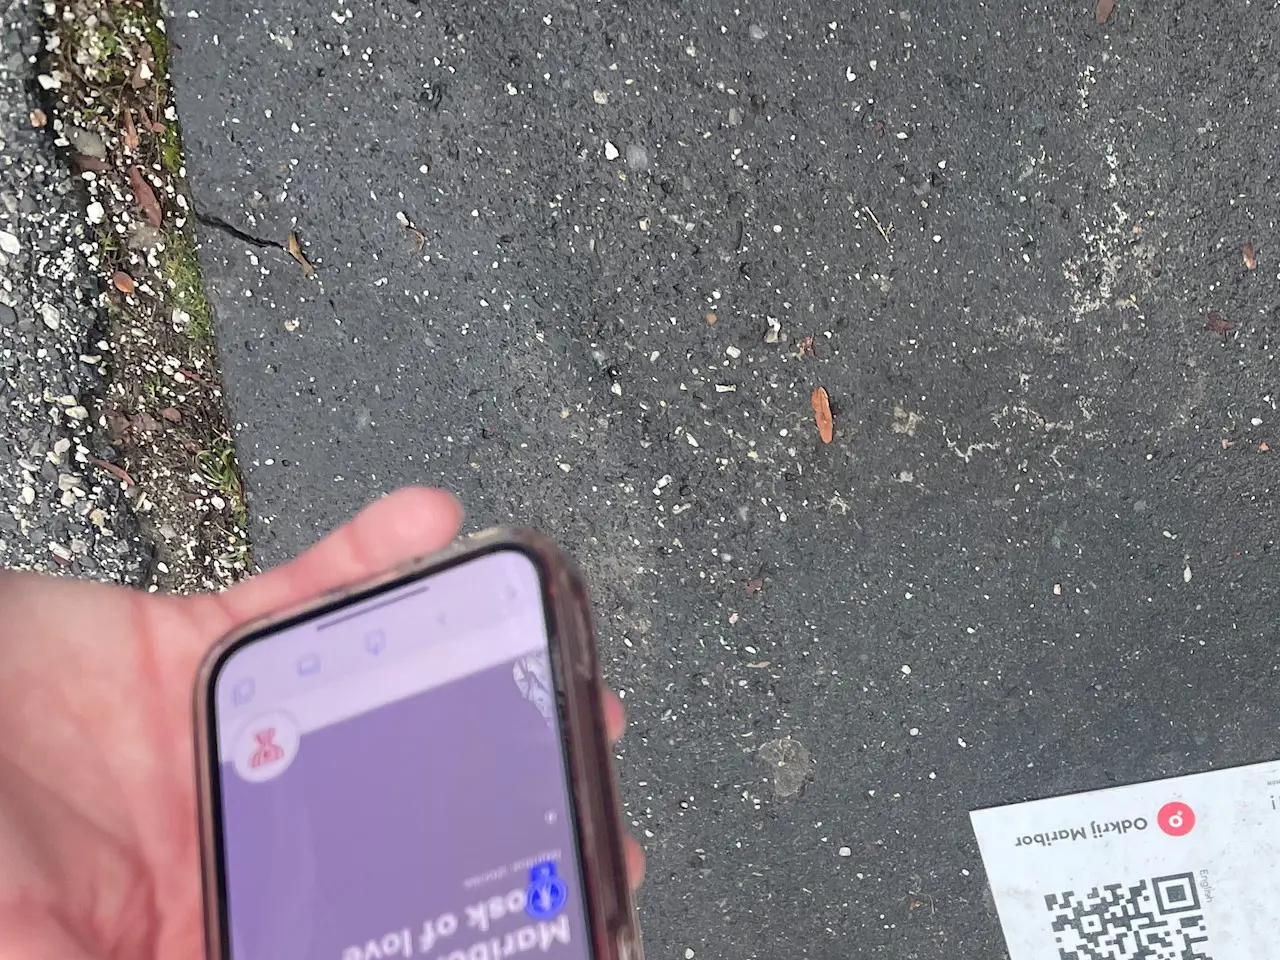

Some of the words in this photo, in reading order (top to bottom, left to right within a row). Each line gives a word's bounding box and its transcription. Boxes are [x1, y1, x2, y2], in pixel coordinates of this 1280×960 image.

[1015, 827, 1087, 847] Maribor
[1091, 817, 1148, 839] Odkrij
[418, 912, 459, 954] of
